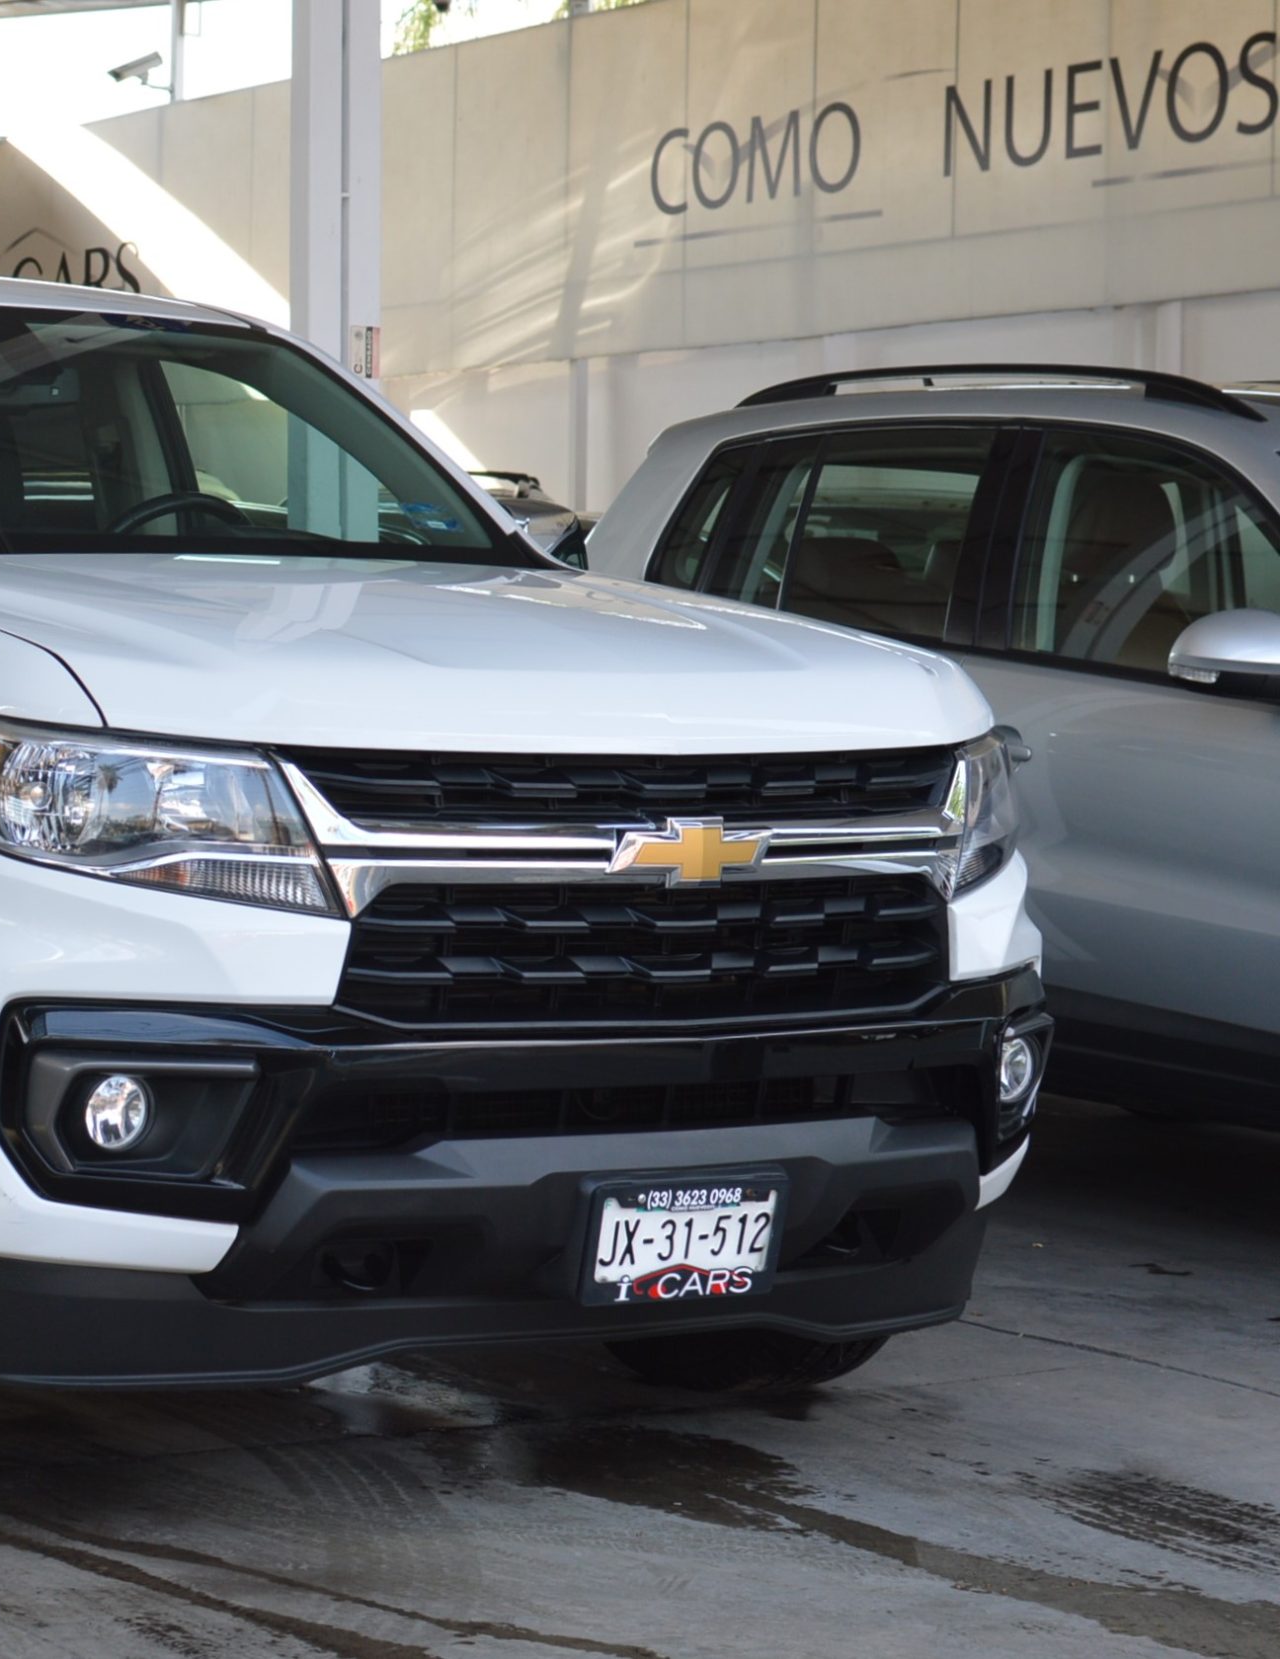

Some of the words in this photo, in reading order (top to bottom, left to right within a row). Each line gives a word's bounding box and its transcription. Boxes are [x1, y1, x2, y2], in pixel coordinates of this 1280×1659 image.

[650, 101, 861, 216] COMO
[943, 30, 1279, 178] NUEVOS
[647, 1189, 673, 1211] (33)
[674, 1188, 708, 1208] 3623
[709, 1187, 743, 1205] 0968
[598, 1211, 771, 1268] JX-31-512
[657, 1266, 753, 1300] CARS
